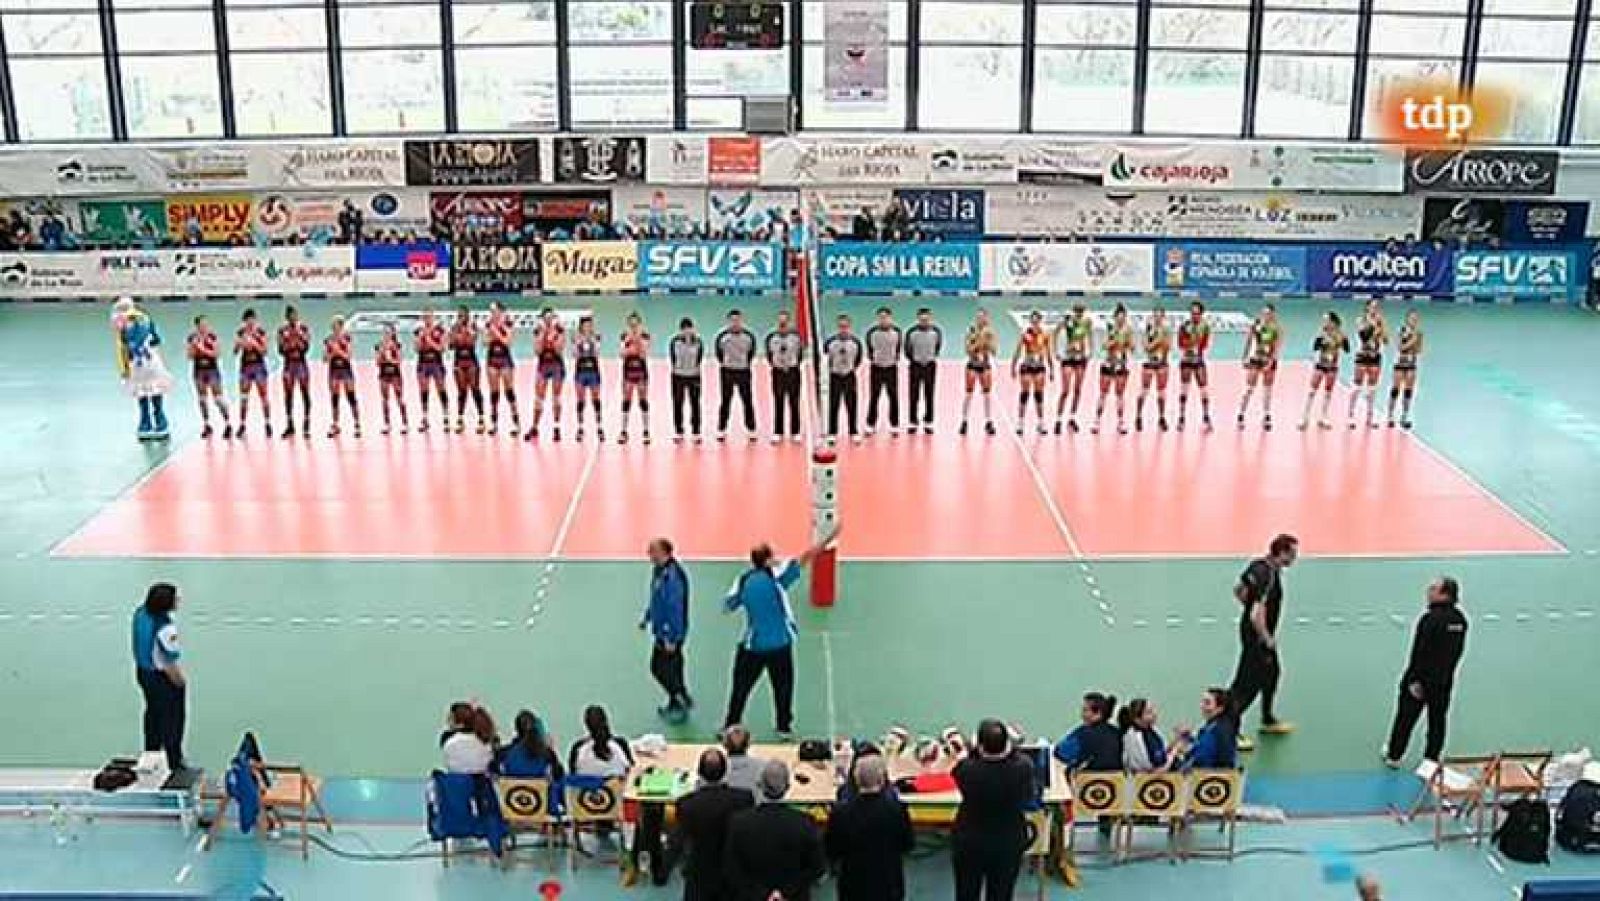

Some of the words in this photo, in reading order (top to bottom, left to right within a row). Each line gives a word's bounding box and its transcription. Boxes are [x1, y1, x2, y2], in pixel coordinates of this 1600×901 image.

[647, 245, 727, 274] SFV
[826, 256, 869, 277] COPA
[900, 256, 920, 277] LA
[922, 255, 972, 279] REINA
[1333, 252, 1426, 278] molten
[1456, 256, 1527, 285] SFV
